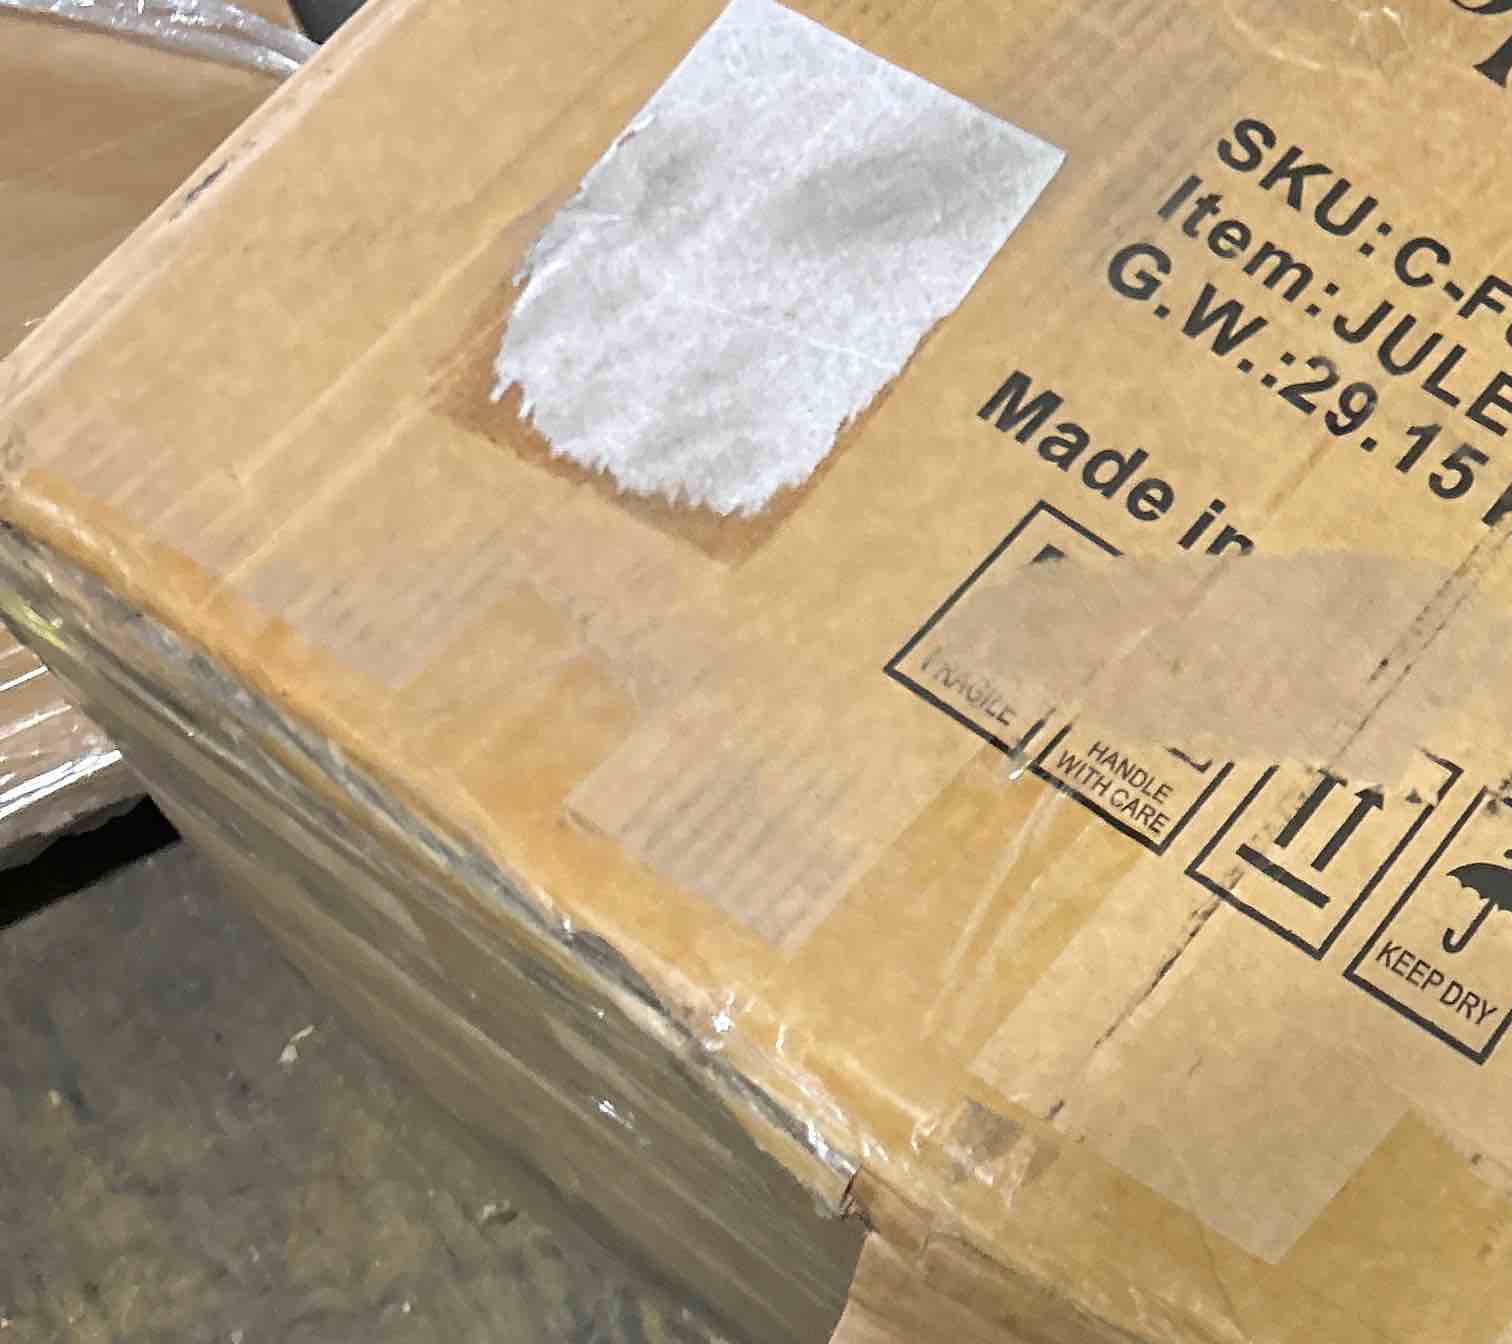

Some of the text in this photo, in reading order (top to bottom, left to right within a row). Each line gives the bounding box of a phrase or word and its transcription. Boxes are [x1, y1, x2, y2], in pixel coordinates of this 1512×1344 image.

[976, 369, 1175, 522] Made
[1056, 749, 1171, 836] WITH CARE
[1087, 740, 1174, 805] HANDLE
[1375, 940, 1499, 1025] KEEP DRY
